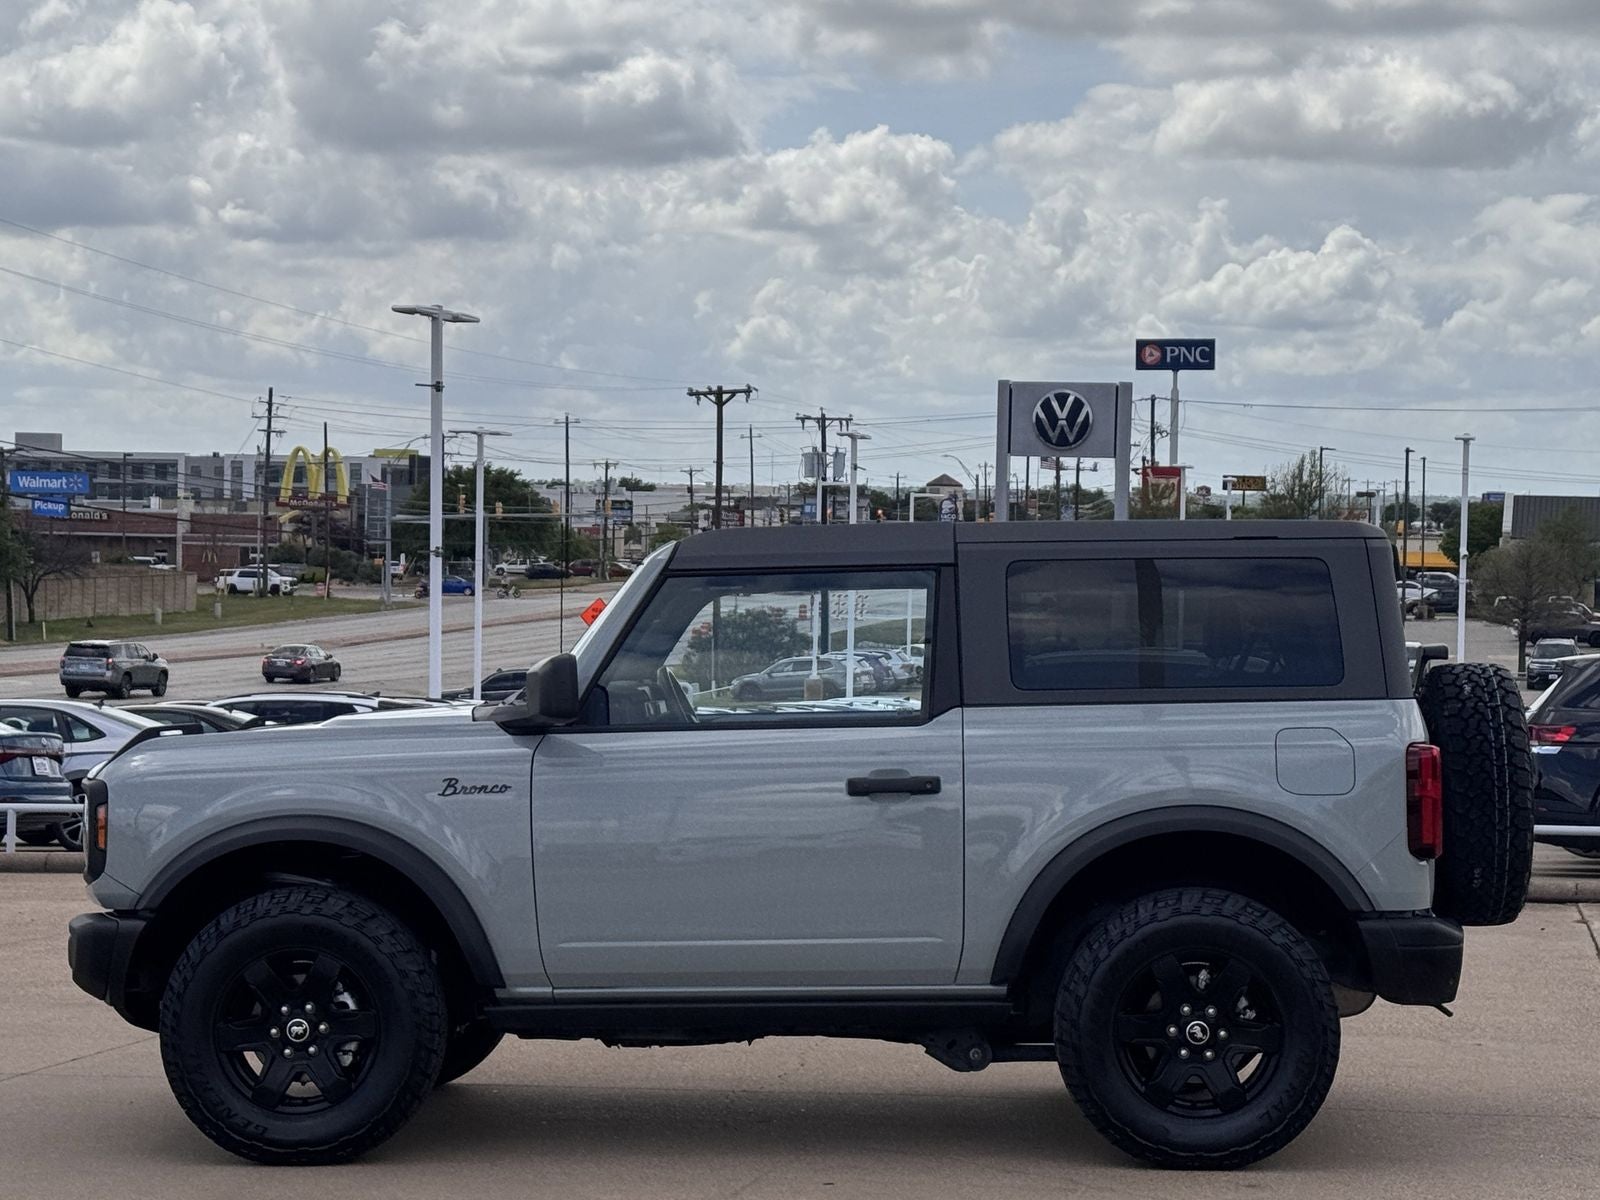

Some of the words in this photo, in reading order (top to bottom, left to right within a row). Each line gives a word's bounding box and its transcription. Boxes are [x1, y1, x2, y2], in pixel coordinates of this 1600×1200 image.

[1164, 345, 1210, 363] PNC
[17, 475, 67, 489] Walmart
[34, 500, 65, 513] Pickup
[437, 777, 513, 797] Bronco
